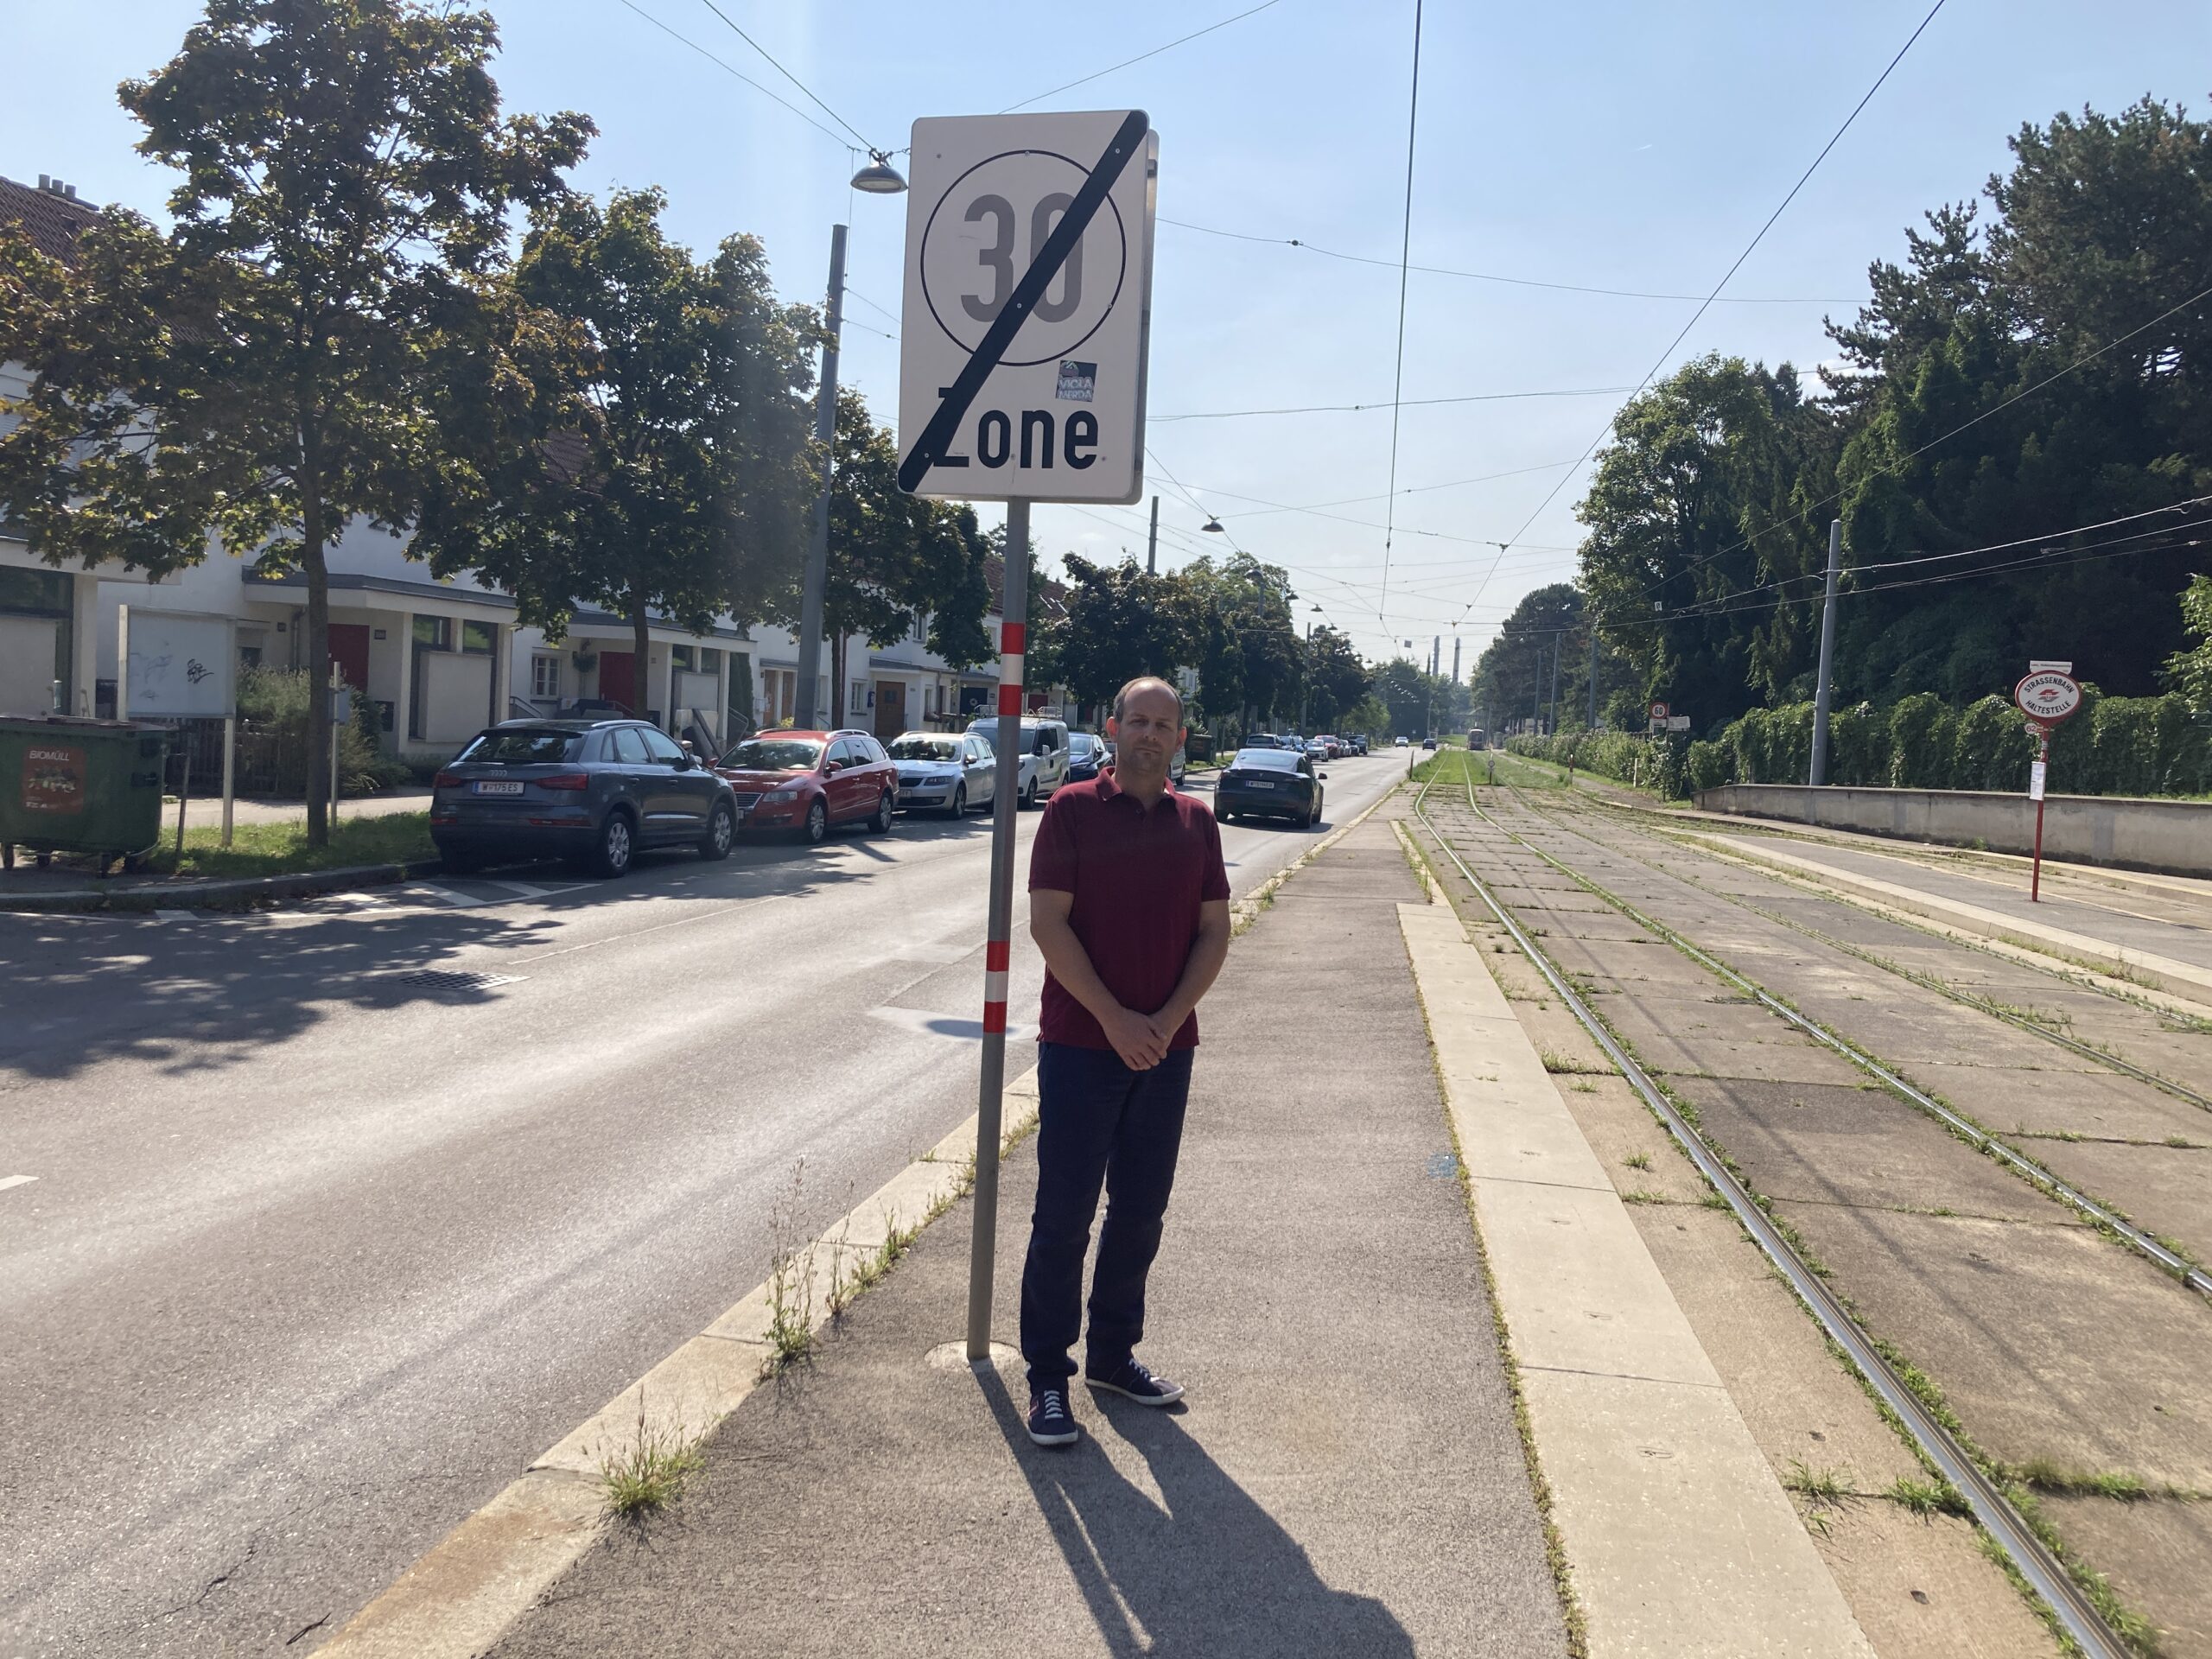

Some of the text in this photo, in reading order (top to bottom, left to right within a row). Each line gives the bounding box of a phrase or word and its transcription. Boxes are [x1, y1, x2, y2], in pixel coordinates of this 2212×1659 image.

[961, 193, 1083, 322] 30
[934, 387, 1098, 469] Zone
[2024, 677, 2075, 693] STRASSENBAHN
[2025, 700, 2071, 714] HALTESTELLE
[29, 750, 69, 760] BIOMÜLL
